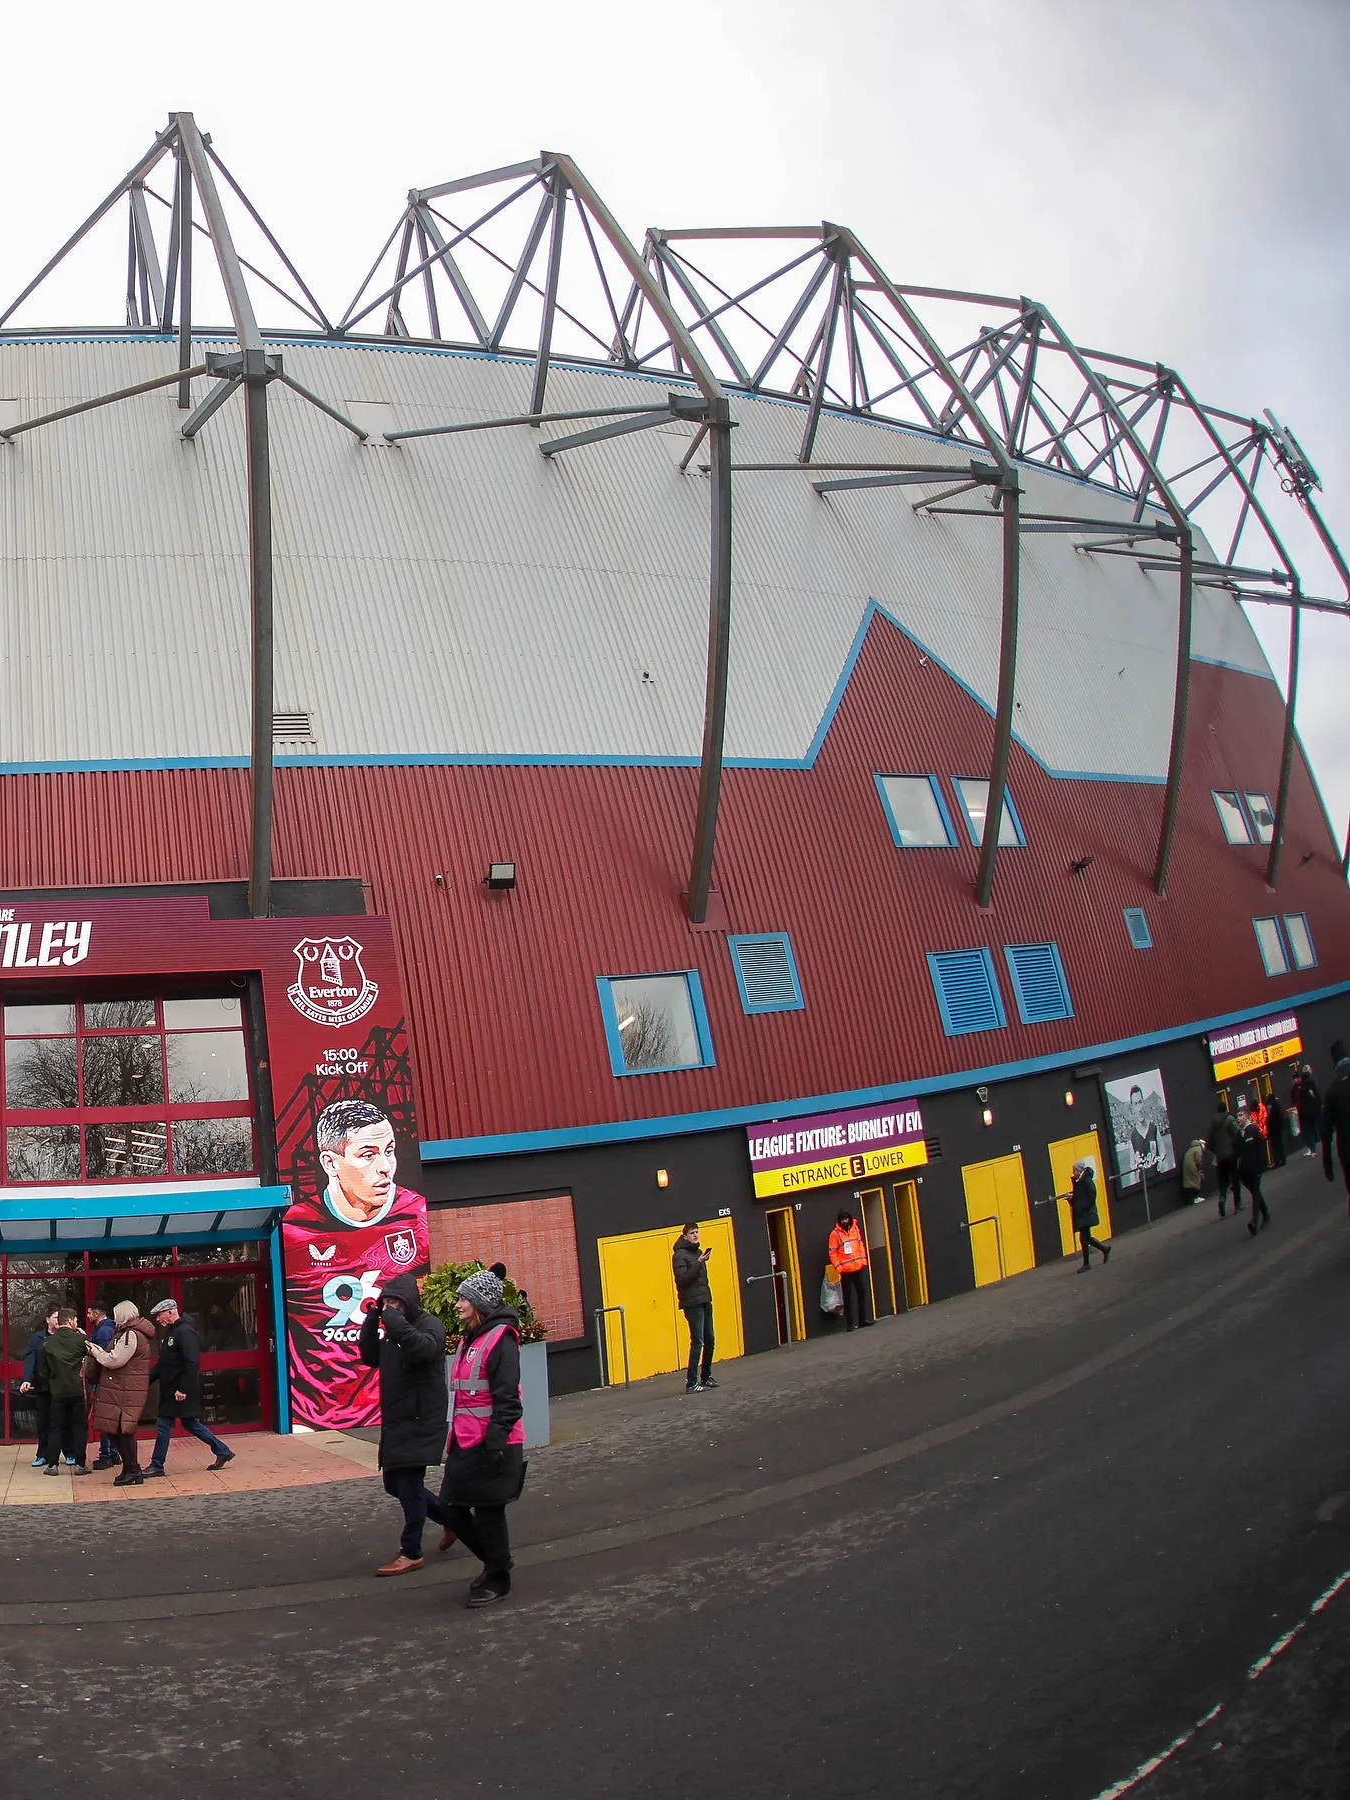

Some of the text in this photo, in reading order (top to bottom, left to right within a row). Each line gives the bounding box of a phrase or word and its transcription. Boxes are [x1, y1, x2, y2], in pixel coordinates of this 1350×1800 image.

[309, 986, 358, 998] Everton
[323, 1048, 358, 1061] 15:00
[315, 1062, 368, 1076] Kick Off
[749, 1133, 794, 1160] LEAGUE
[796, 1125, 847, 1154] FIXTURE:
[847, 1115, 895, 1143] BURNLEY
[895, 1113, 904, 1134] V
[782, 1151, 904, 1187] ENTRANCE E LOWER
[795, 1203, 802, 1211] 17
[322, 1269, 382, 1326] 96
